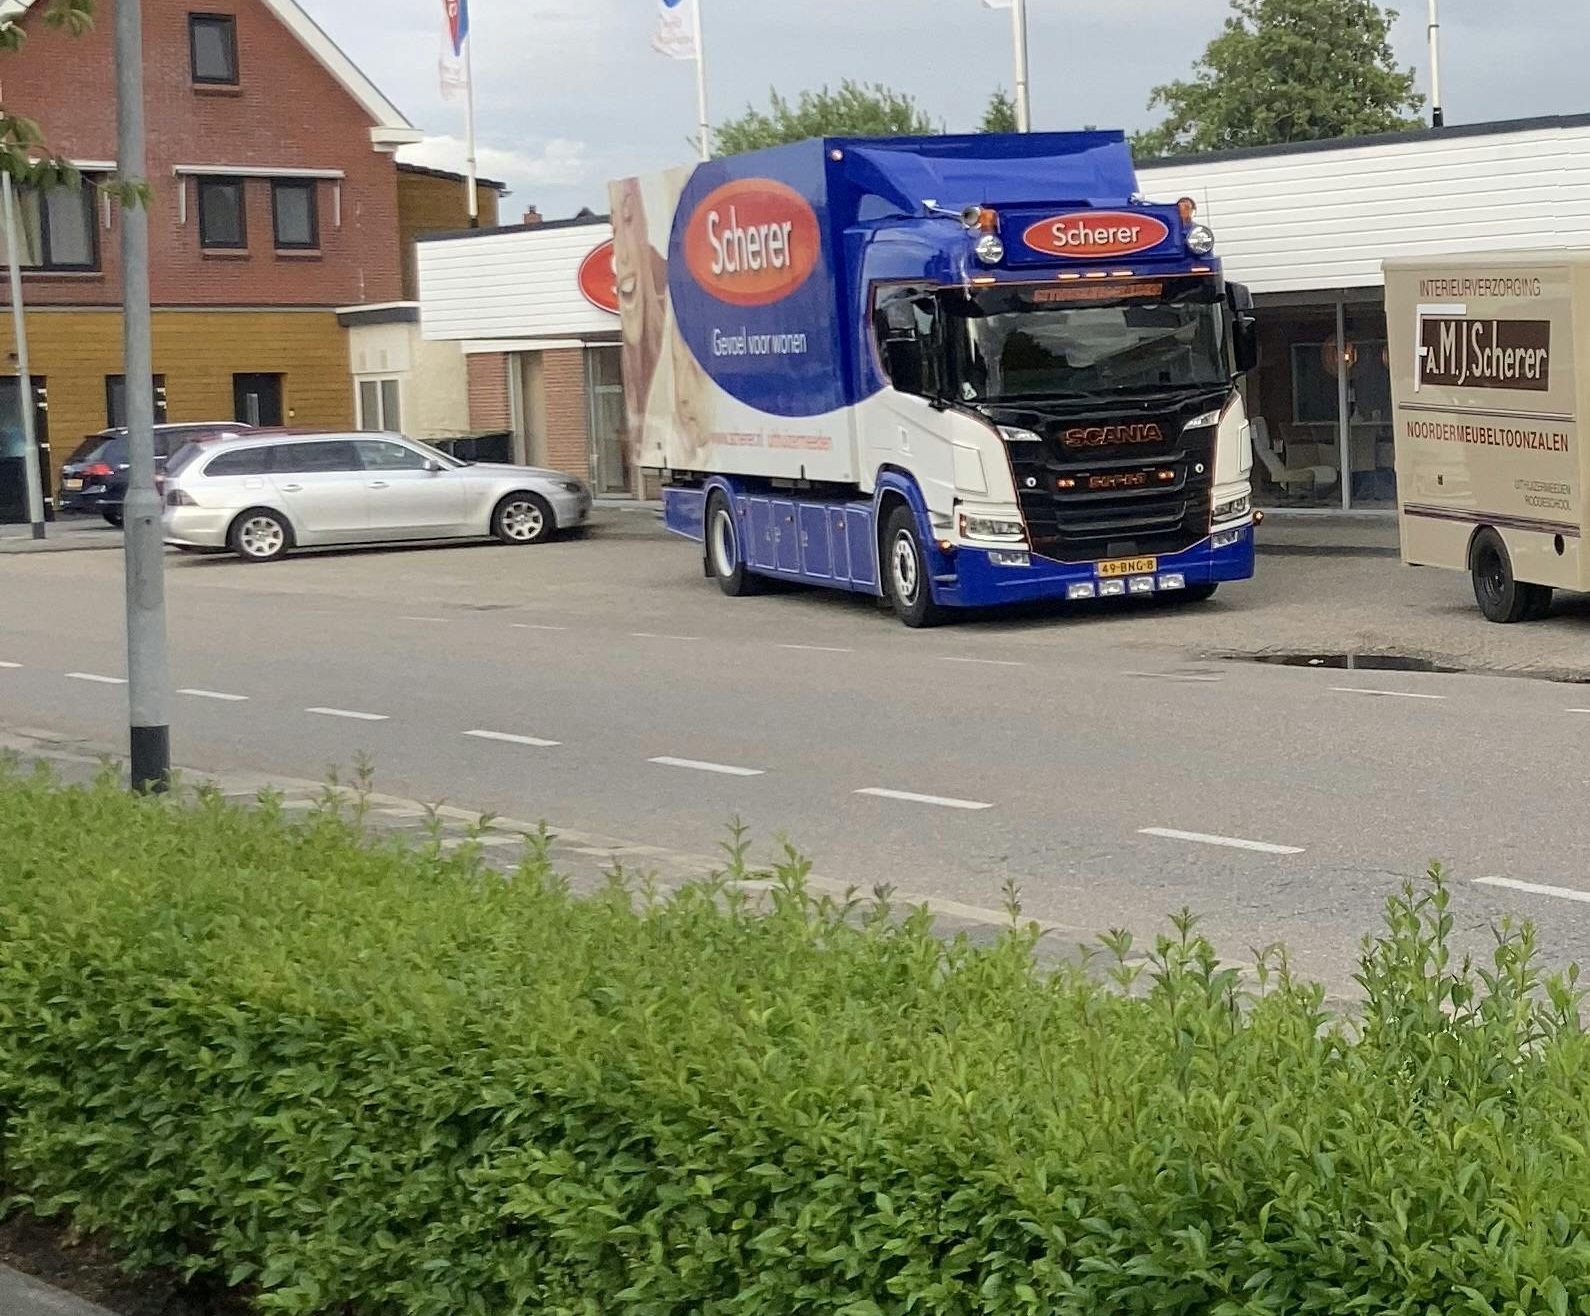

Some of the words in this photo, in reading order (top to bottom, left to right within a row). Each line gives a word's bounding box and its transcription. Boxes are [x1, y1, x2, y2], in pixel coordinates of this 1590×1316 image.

[707, 205, 792, 275] Scherer
[1052, 221, 1140, 247] Scherer
[1419, 278, 1541, 297] INTERIEURVERZORGING
[1471, 321, 1548, 381] Scherer
[1065, 424, 1164, 447] SCANIA
[1407, 421, 1569, 452] NOORDERMEUBELTOONZALEN
[1102, 559, 1154, 573] 49-BNG-8
